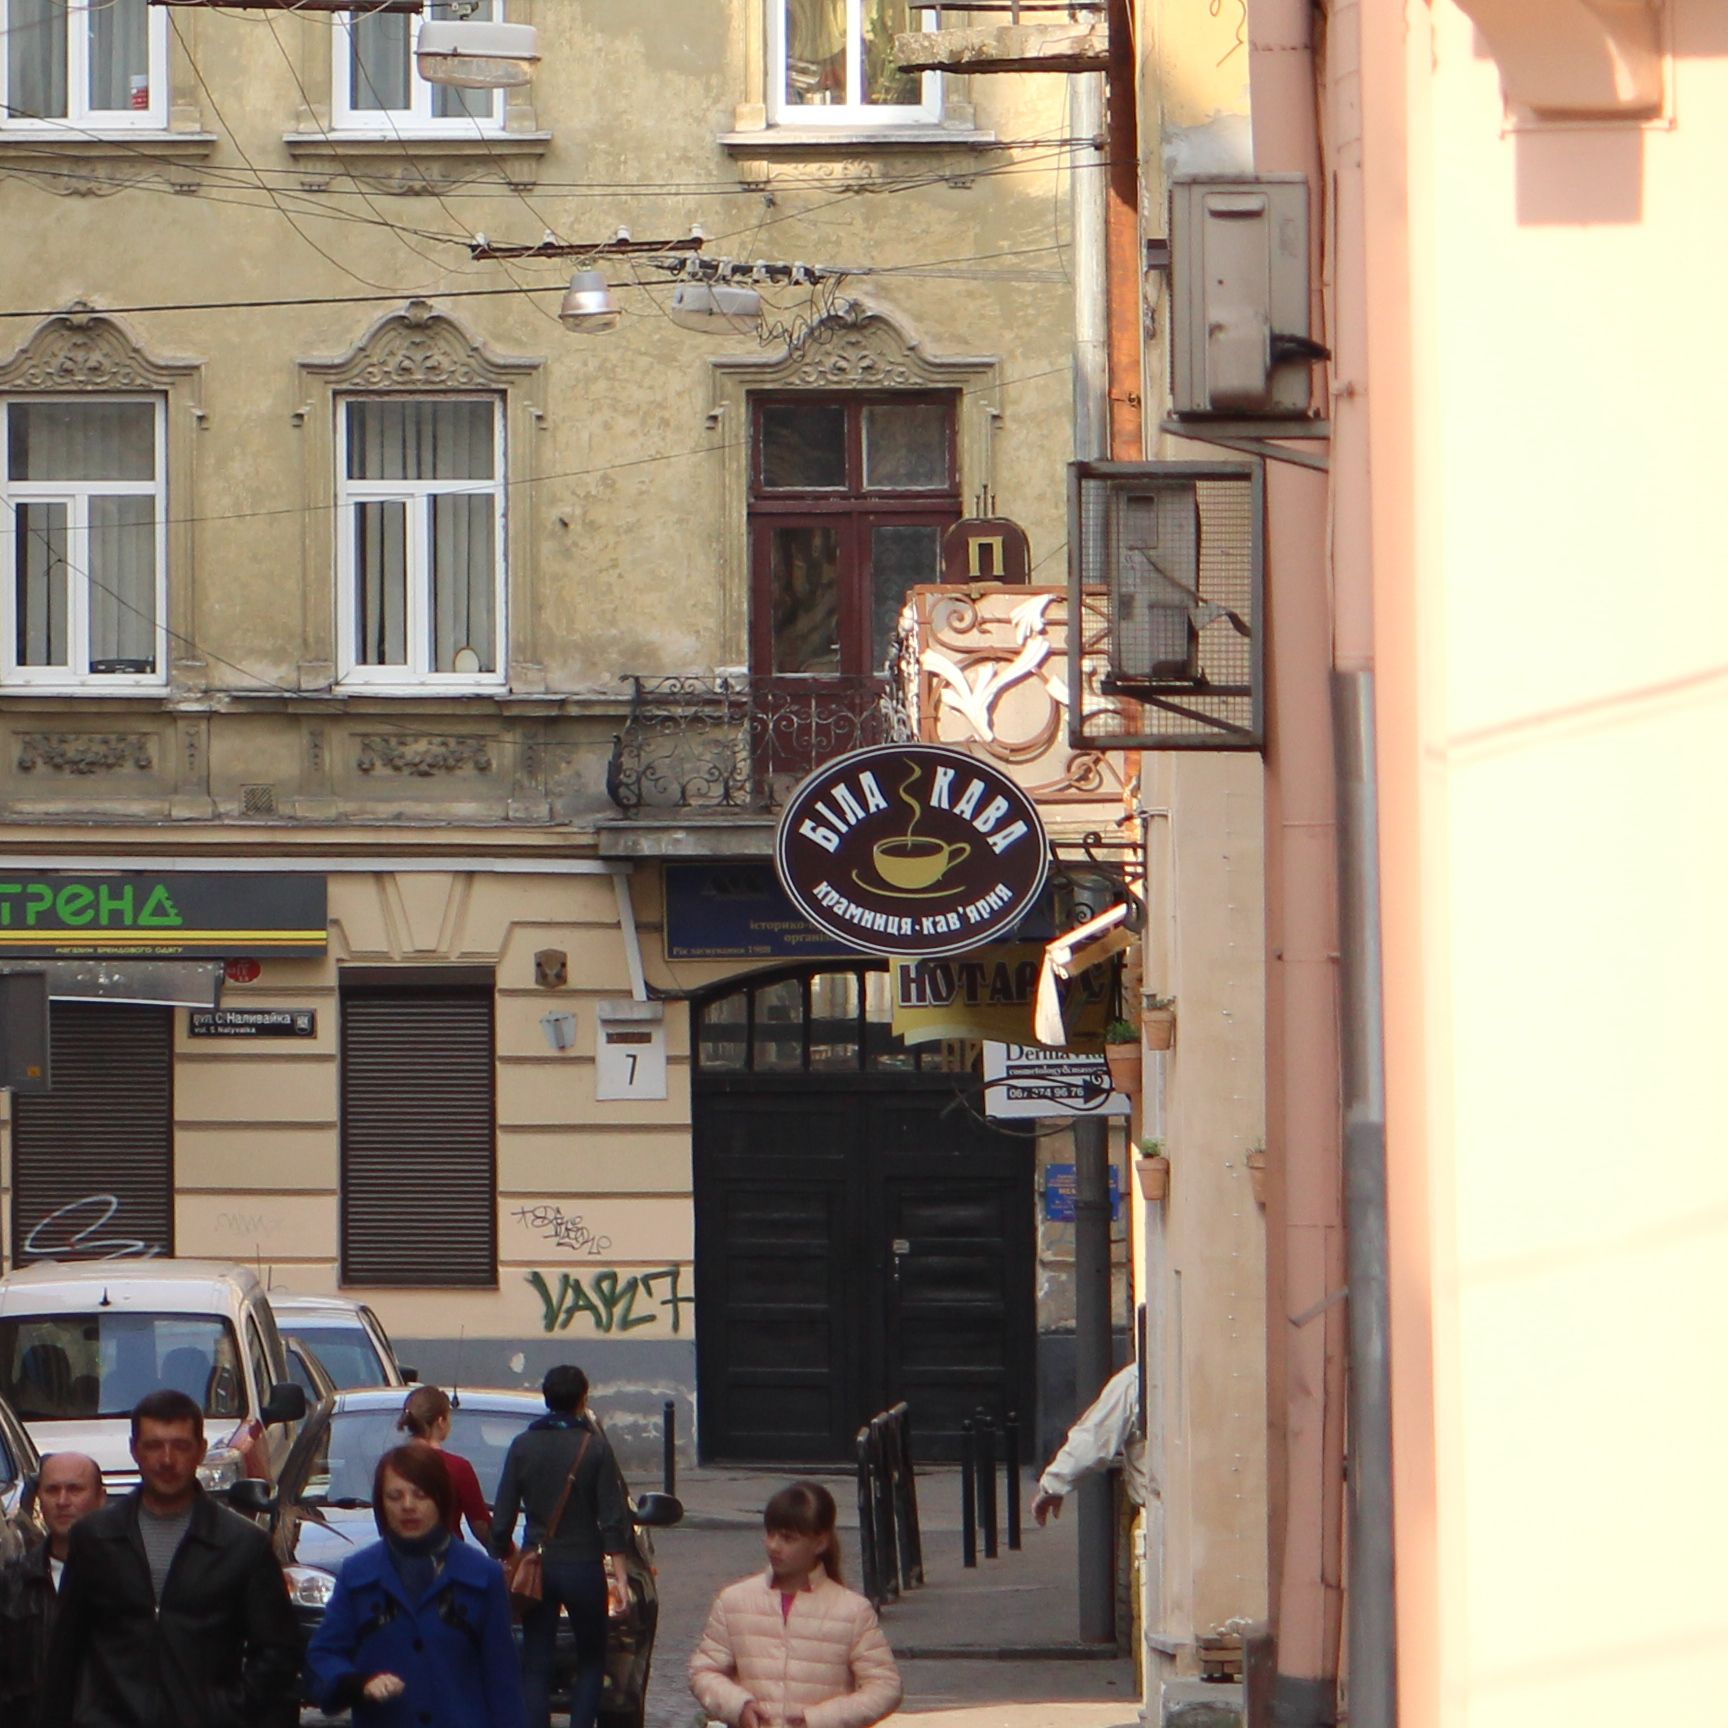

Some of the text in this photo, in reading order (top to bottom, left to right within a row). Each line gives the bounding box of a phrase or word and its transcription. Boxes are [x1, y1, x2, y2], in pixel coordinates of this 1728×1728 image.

[798, 765, 1029, 855] БІЛА КАВА
[898, 958, 1107, 1008] НОТАРС
[625, 1054, 638, 1086] 7
